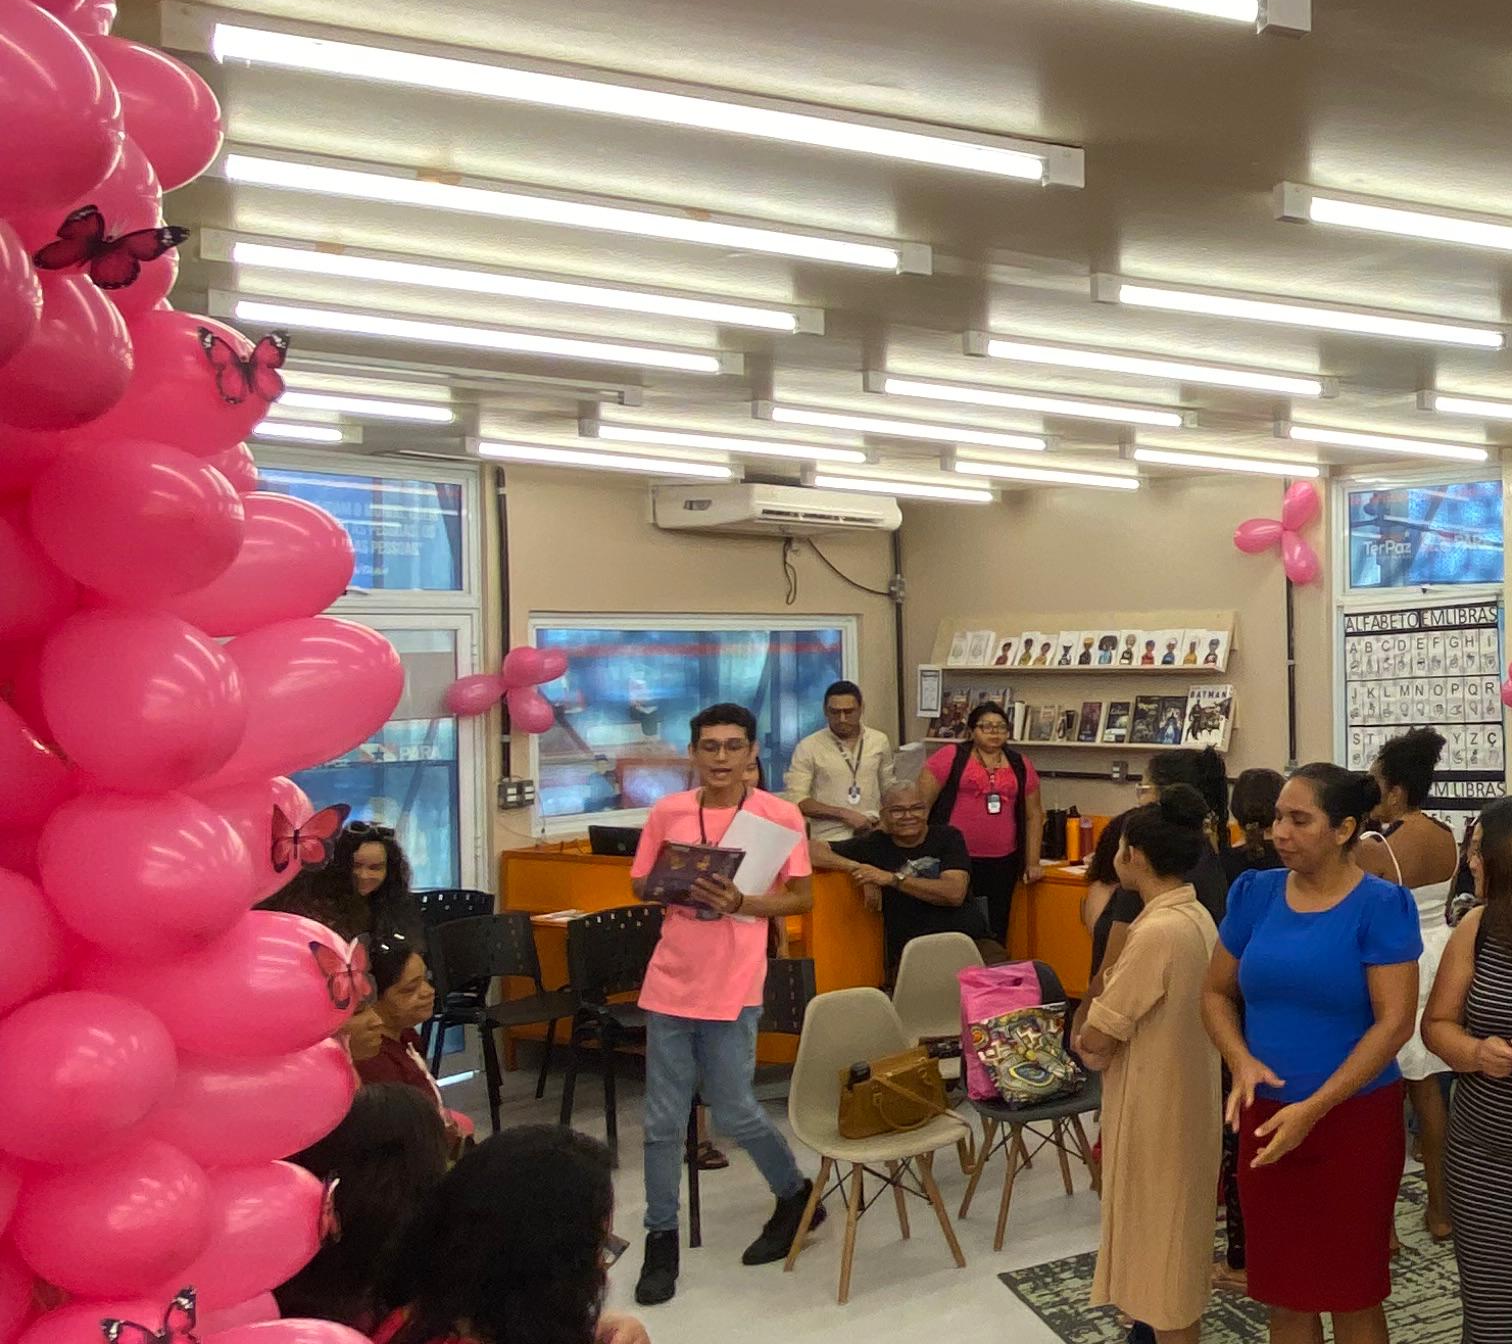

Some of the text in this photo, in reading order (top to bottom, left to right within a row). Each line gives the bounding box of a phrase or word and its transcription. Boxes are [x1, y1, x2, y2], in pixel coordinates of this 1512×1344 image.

[1364, 540, 1412, 555] TerPaz
[1346, 606, 1498, 633] ALFABETO EM LIBRAS
[1350, 643, 1358, 654] A
[1365, 642, 1373, 653] B
[1381, 640, 1391, 652] C
[1397, 640, 1407, 651] D
[1417, 638, 1424, 649] E
[1433, 637, 1440, 648] F
[1450, 636, 1459, 648] G
[1465, 636, 1474, 648] H
[1190, 690, 1227, 699] BATMAN
[1352, 682, 1495, 699] J K L M N O P Q R
[1353, 733, 1361, 745] S
[1367, 733, 1375, 745] T
[1453, 733, 1462, 744] Y
[1470, 733, 1478, 744] Z
[1487, 732, 1497, 749] Ç
[1430, 782, 1506, 797] M LIBRAS
